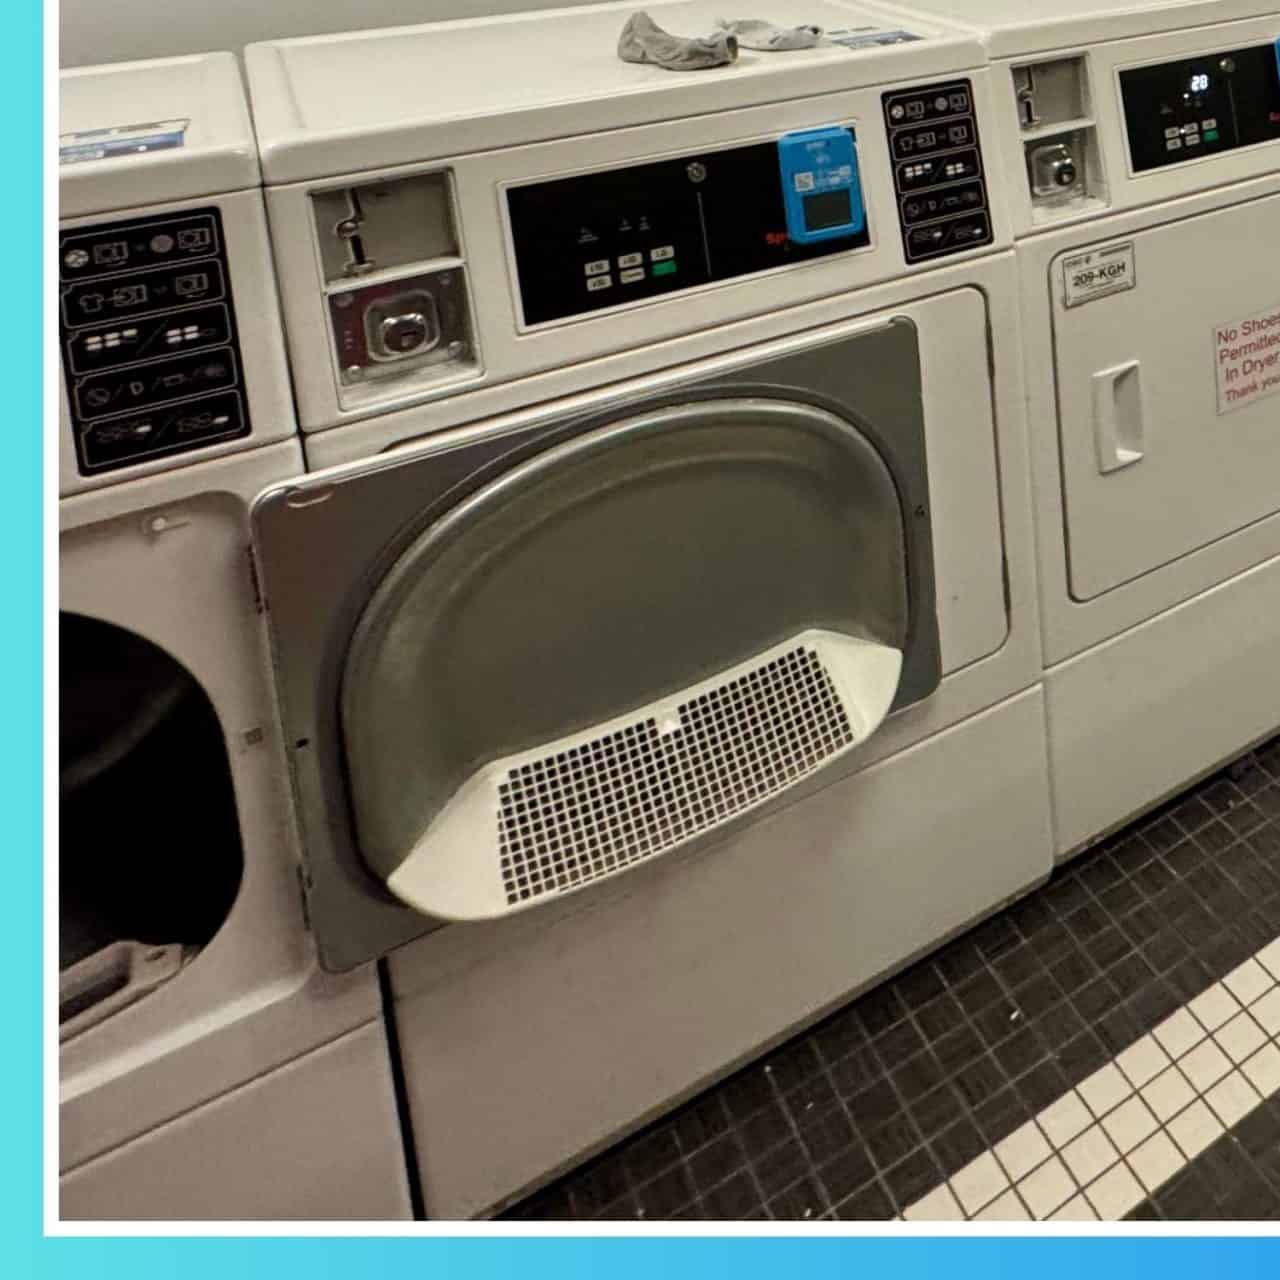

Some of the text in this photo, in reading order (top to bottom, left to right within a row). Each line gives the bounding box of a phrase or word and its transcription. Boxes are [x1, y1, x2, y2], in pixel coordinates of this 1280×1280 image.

[1072, 262, 1127, 287] 209-KGH
[1217, 329, 1238, 345] No
[1225, 351, 1280, 382] In Dryer
[1225, 378, 1258, 401] Thank
